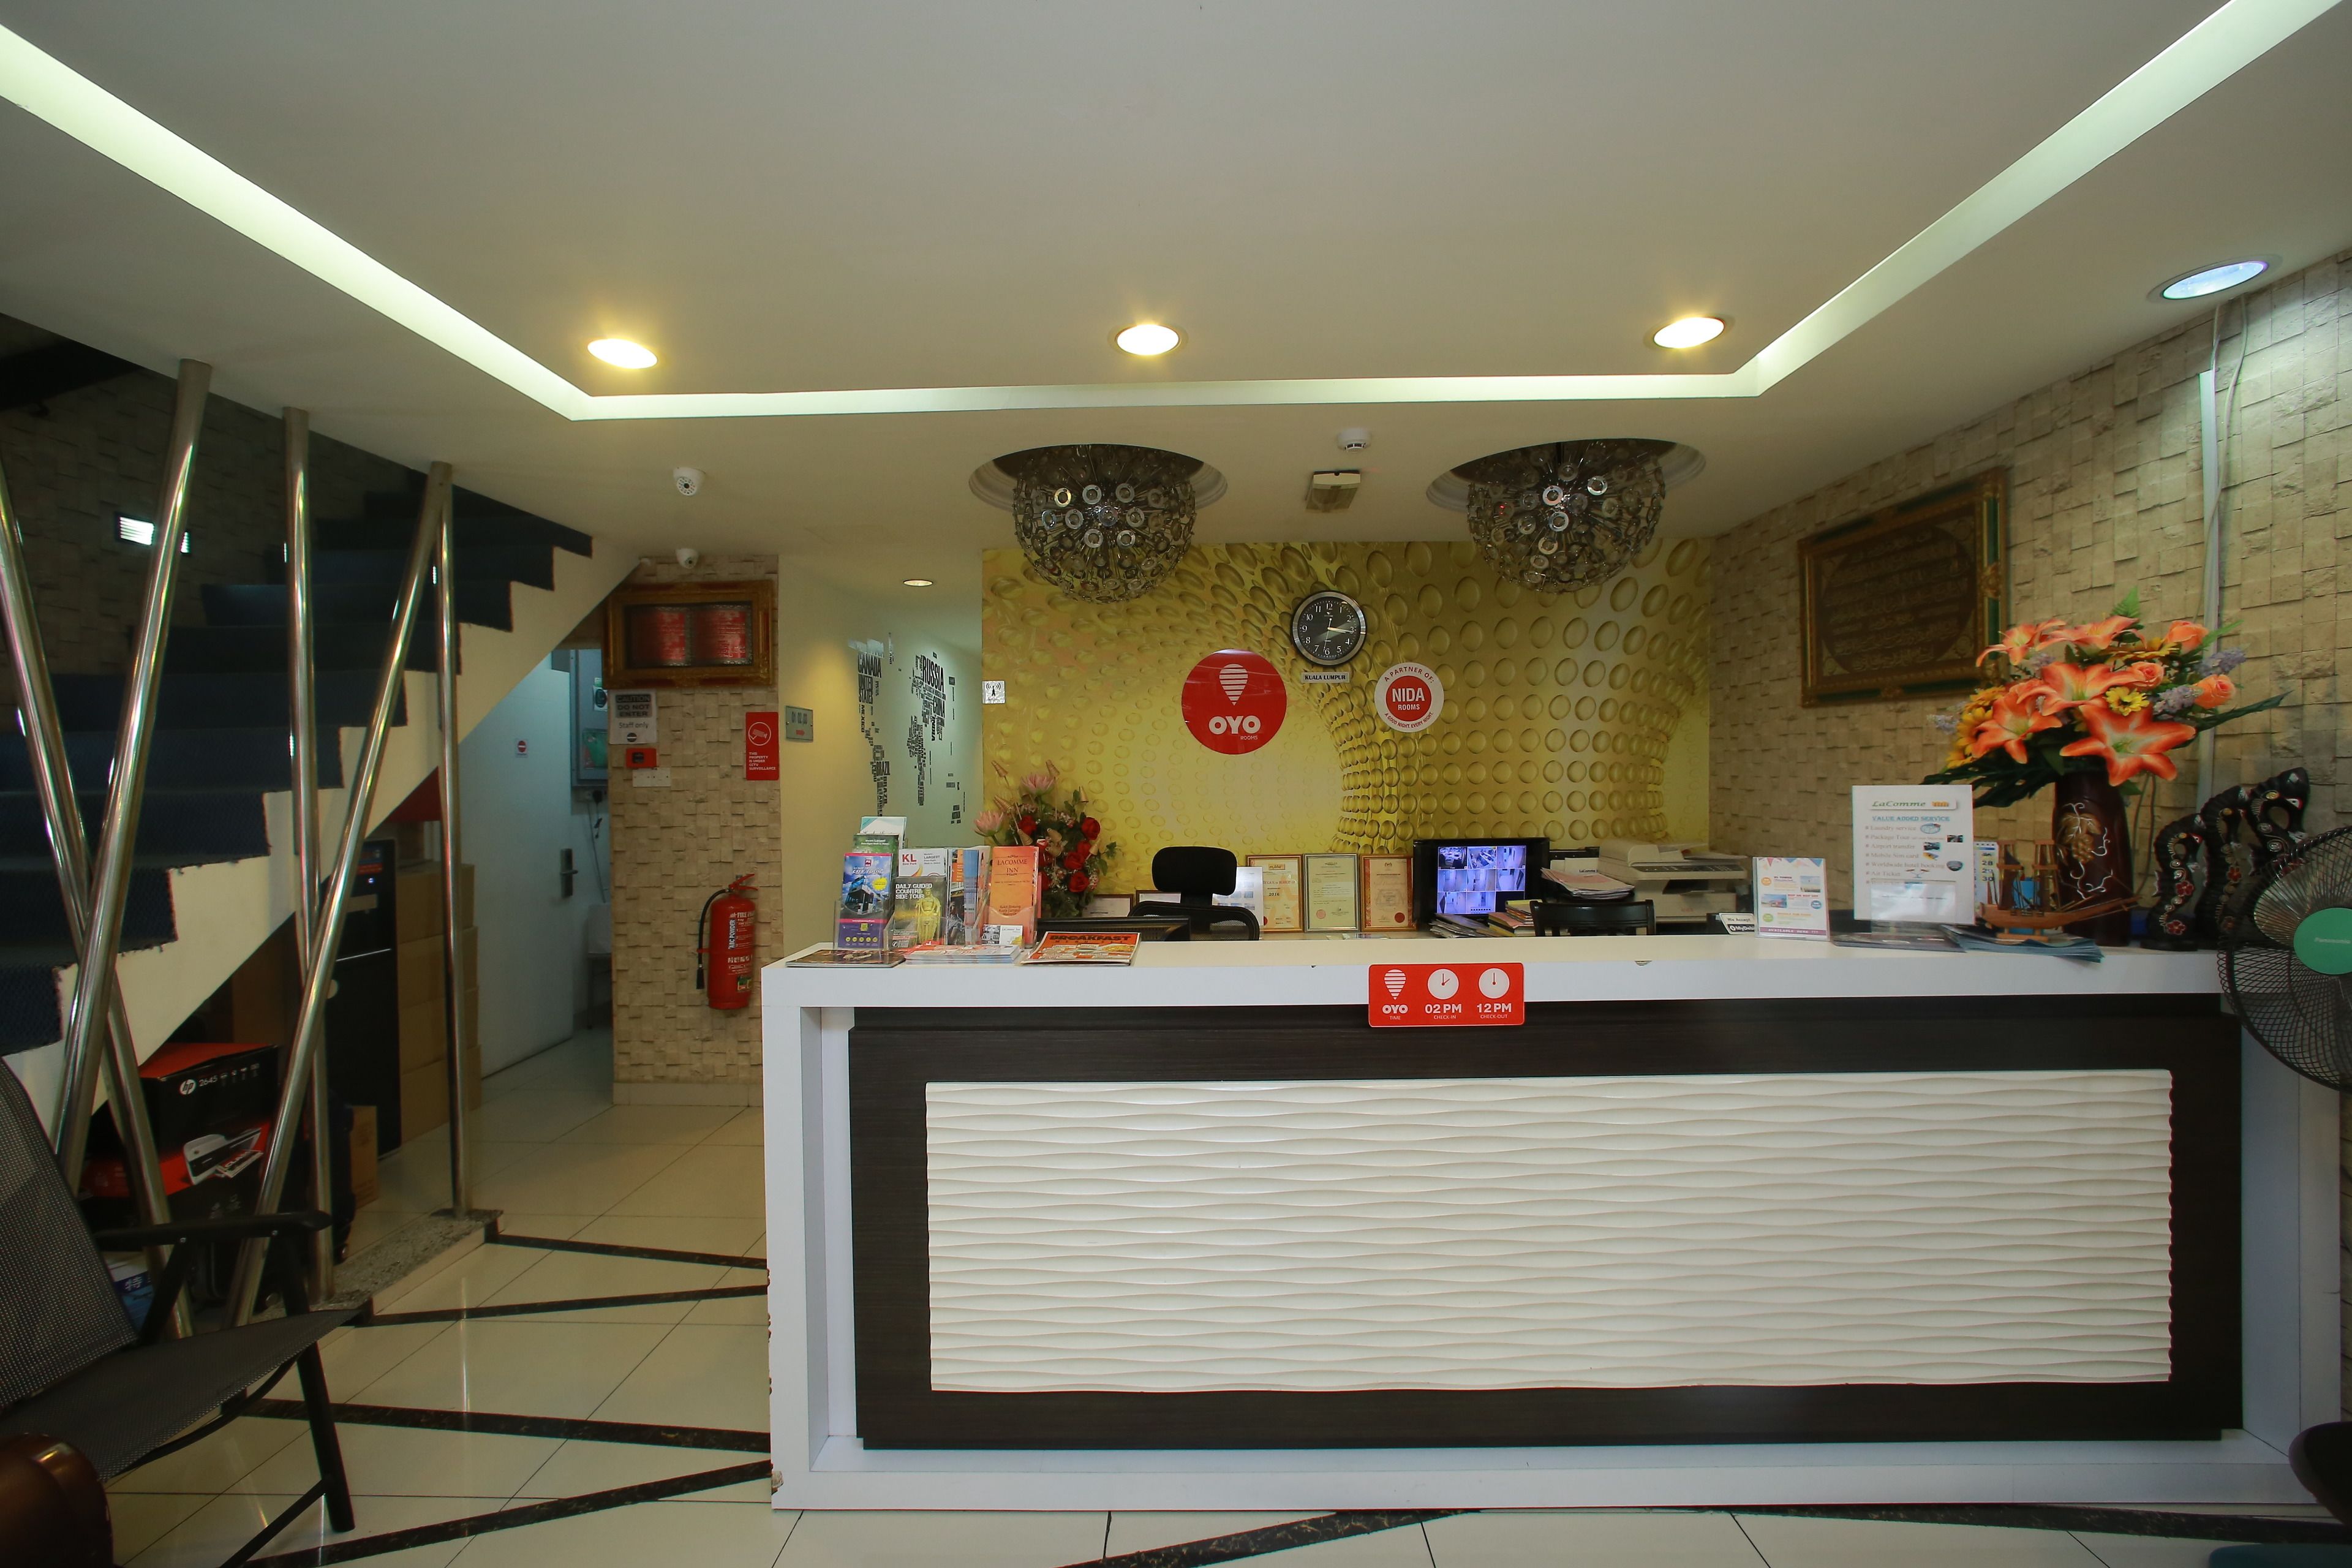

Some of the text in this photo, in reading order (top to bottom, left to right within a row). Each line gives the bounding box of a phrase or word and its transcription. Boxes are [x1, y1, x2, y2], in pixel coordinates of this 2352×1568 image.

[858, 653, 882, 678] CANADA
[922, 655, 944, 693] RUSSIA
[859, 674, 873, 690] UNITED
[1390, 666, 1422, 677] PARTNER
[1424, 673, 1434, 683] OF:
[859, 687, 873, 704] STATES
[1392, 687, 1425, 703] NIDA
[933, 695, 944, 718] CHINA
[1208, 715, 1261, 735] OYO
[1387, 715, 1397, 725] GOOD
[902, 854, 917, 862] KL
[1382, 1003, 1512, 1014] OYO 02 PM 12 PM
[181, 1079, 195, 1095] hp
[198, 1075, 219, 1087] 2645
